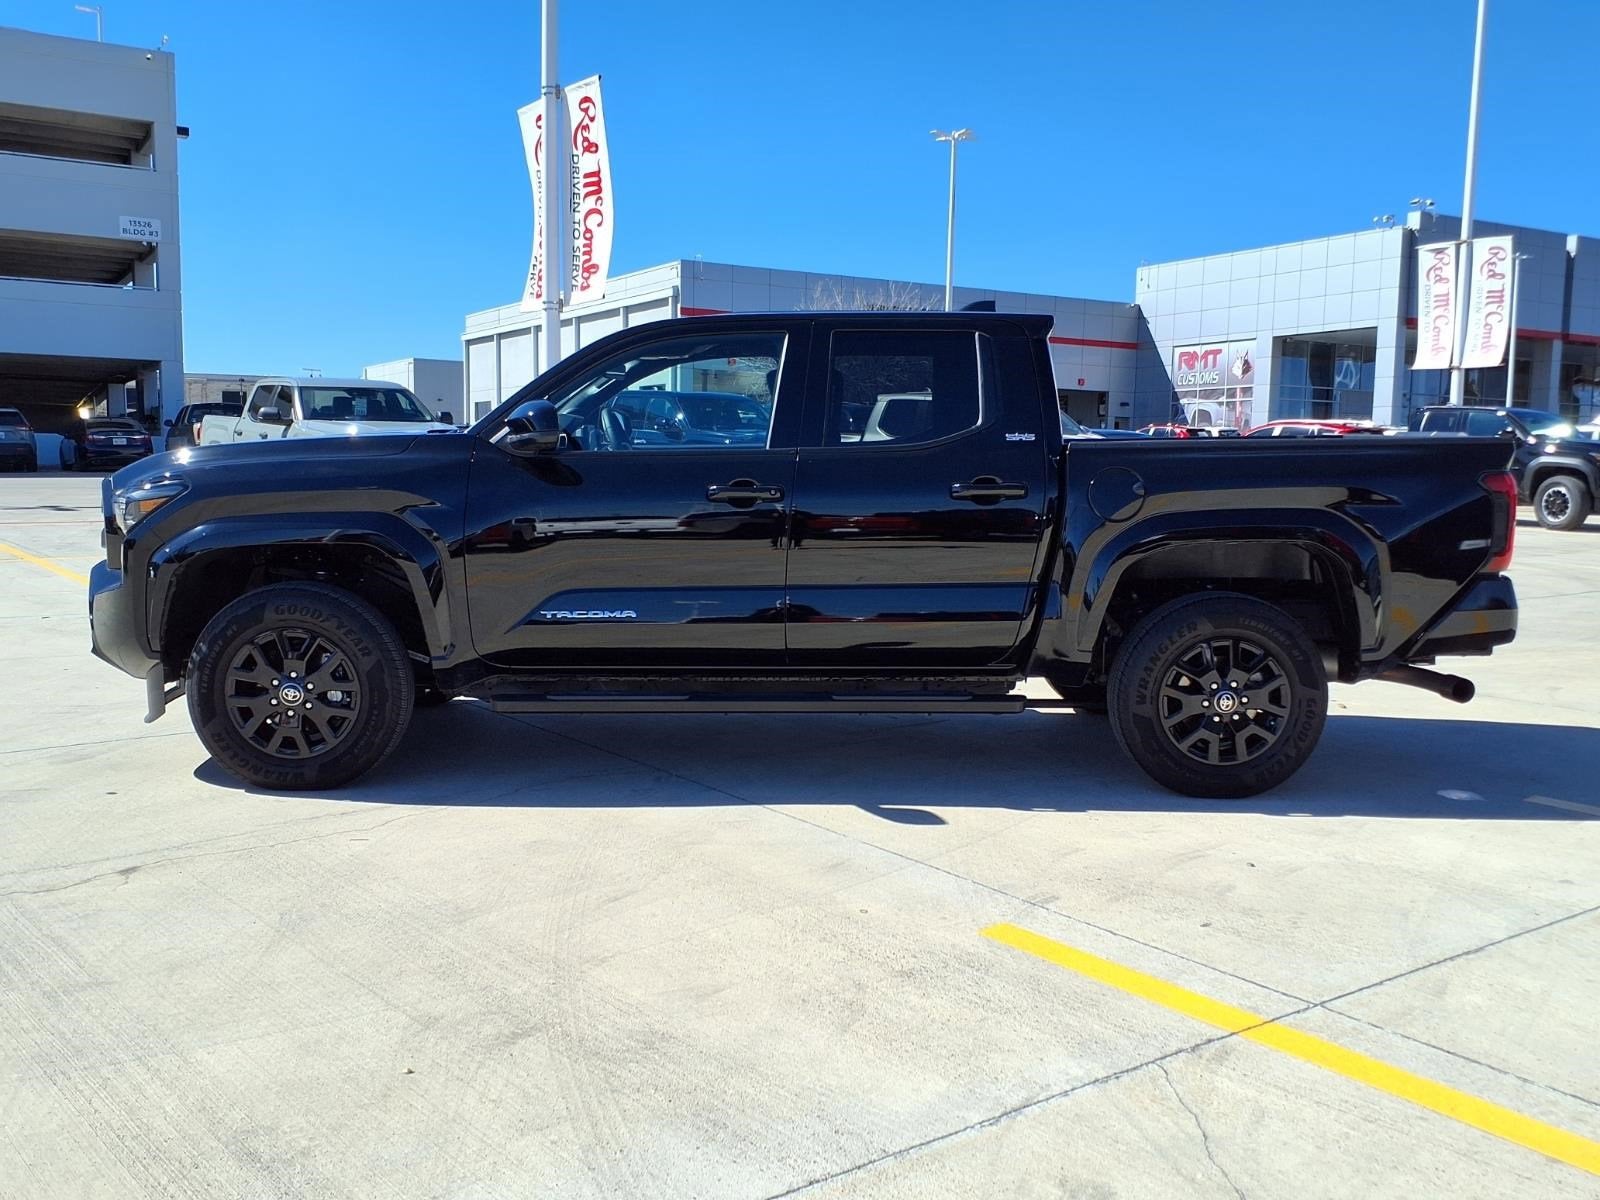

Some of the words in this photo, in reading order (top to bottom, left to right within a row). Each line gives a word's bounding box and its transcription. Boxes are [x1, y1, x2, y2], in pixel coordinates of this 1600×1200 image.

[573, 96, 599, 157] Red
[571, 154, 581, 213] DRIVEN
[122, 227, 146, 237] BLDG
[148, 230, 159, 238] #3
[572, 219, 581, 241] TO
[580, 158, 604, 292] McCombs
[571, 246, 581, 292] SERVE
[1426, 250, 1451, 285] Red
[1480, 246, 1508, 281] Red
[1475, 280, 1484, 313] RIVEN
[1431, 288, 1450, 357] McComb
[1480, 283, 1505, 355] McComb
[1177, 371, 1220, 386] CUSTOMS
[273, 602, 372, 658] GOODYEAR
[540, 610, 637, 619] TACOMA
